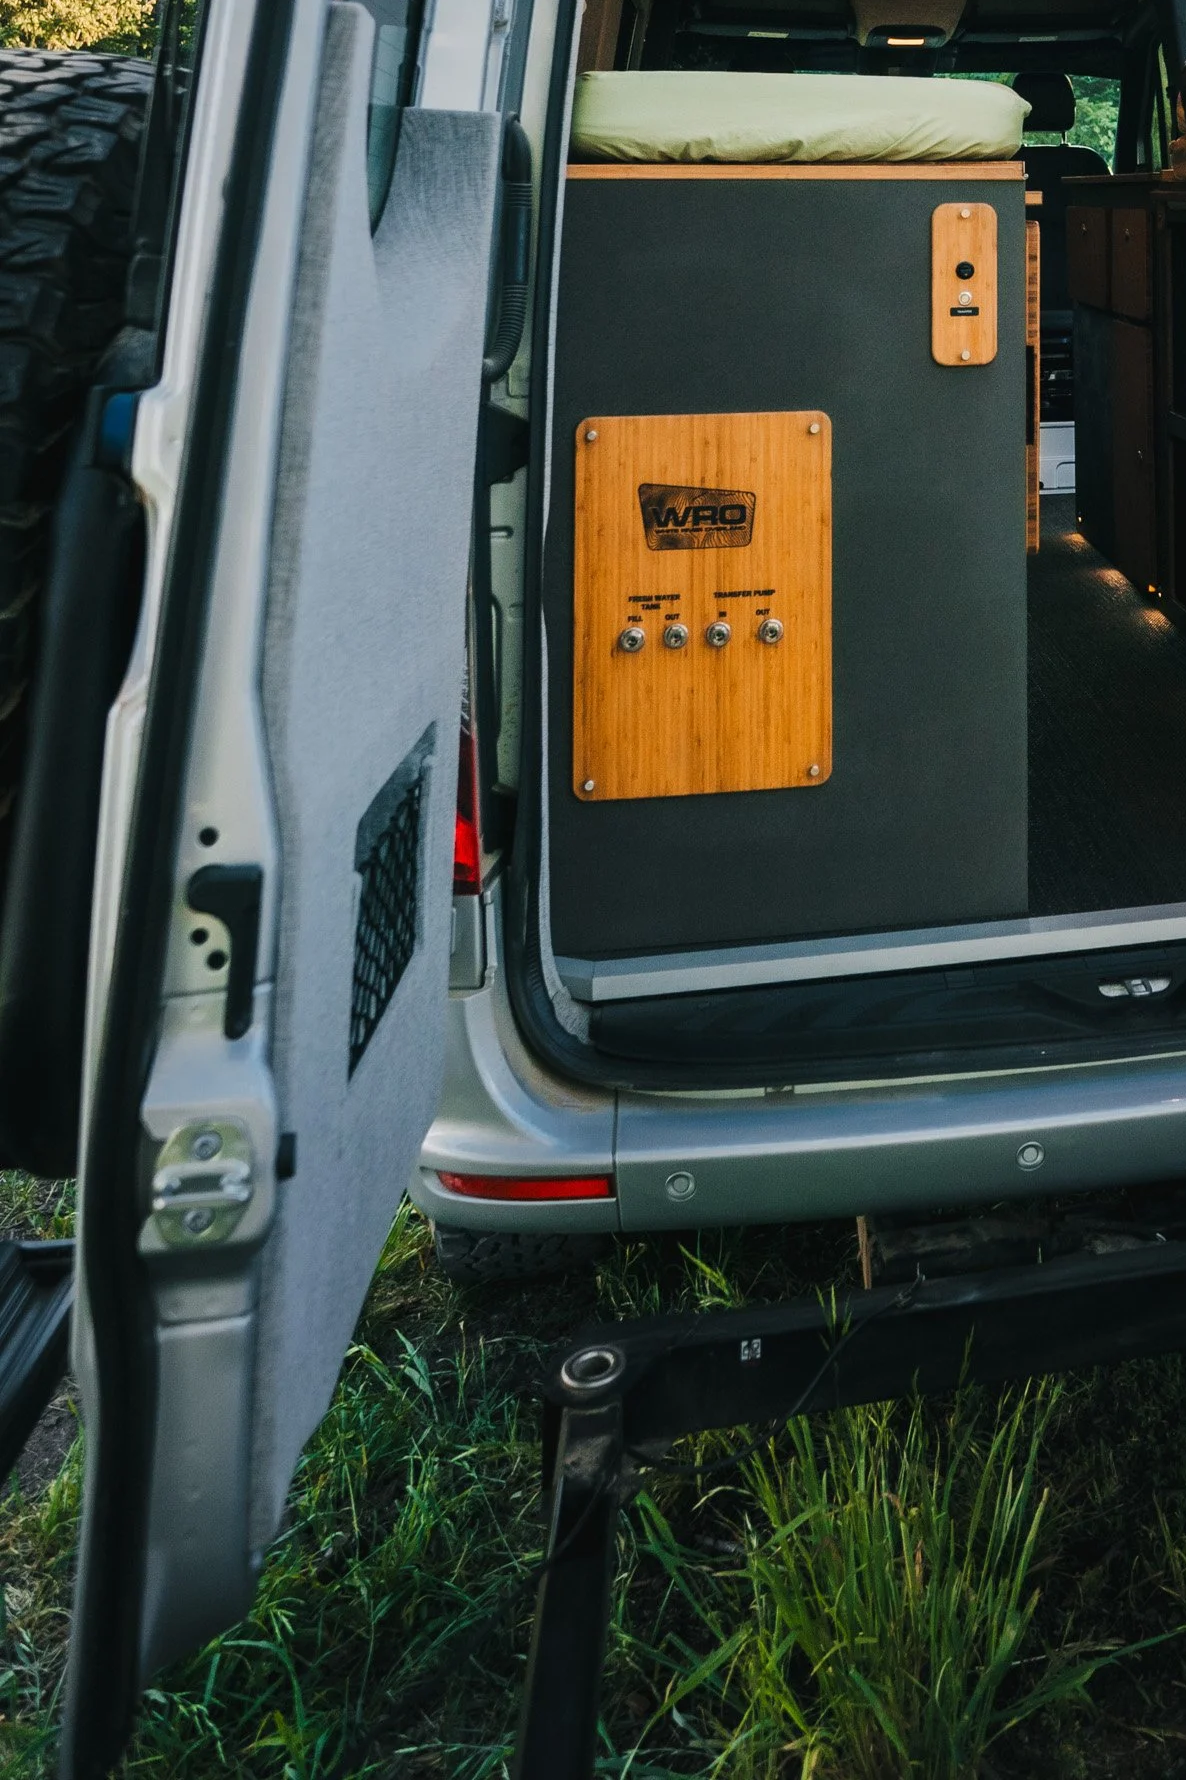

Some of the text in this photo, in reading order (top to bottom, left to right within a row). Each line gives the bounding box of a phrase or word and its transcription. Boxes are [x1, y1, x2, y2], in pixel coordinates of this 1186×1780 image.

[649, 504, 747, 528] WRO
[654, 593, 681, 601] WATER
[713, 590, 752, 599] TRANSFER
[755, 608, 771, 616] OUT
[665, 613, 681, 621] OUT
